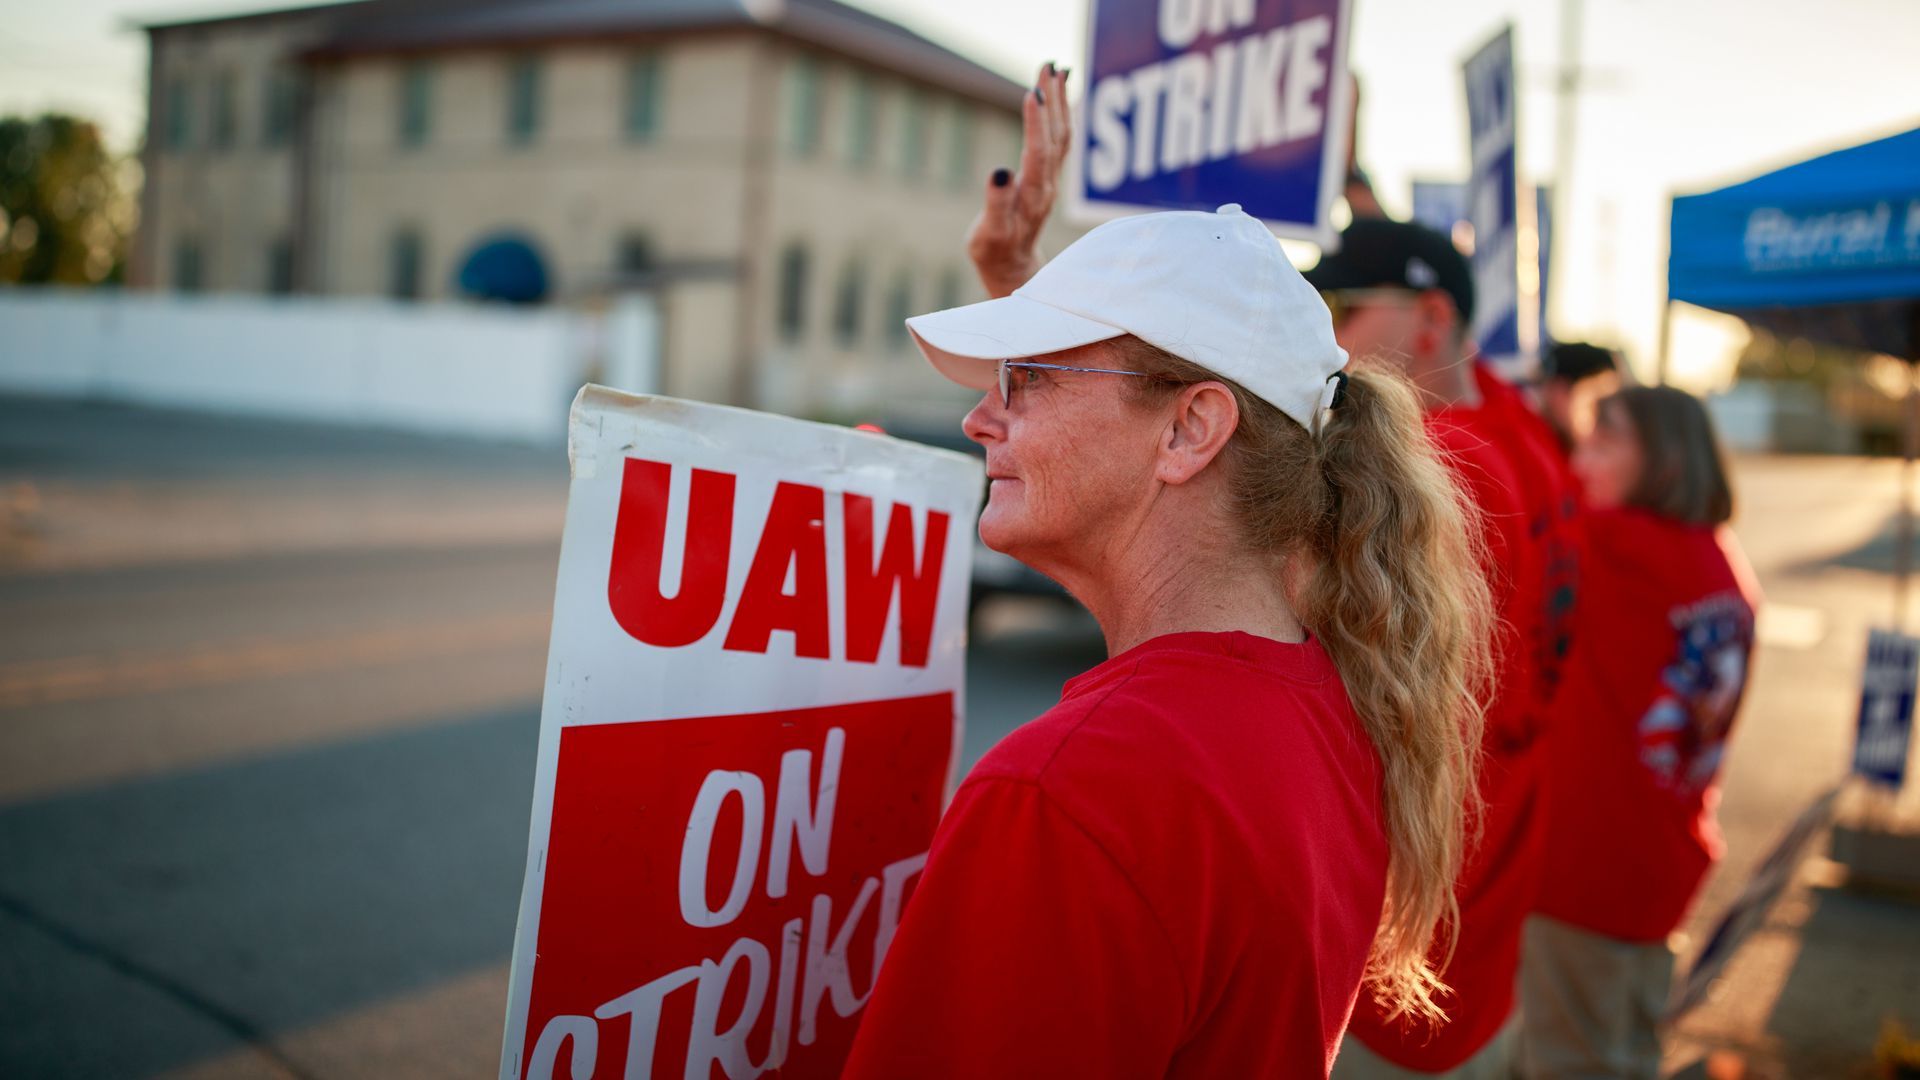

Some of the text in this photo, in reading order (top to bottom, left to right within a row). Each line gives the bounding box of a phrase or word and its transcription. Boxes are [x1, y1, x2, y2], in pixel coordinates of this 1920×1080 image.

[1090, 15, 1331, 191] STRIKE
[608, 457, 949, 668] UAW
[678, 727, 845, 928] ON
